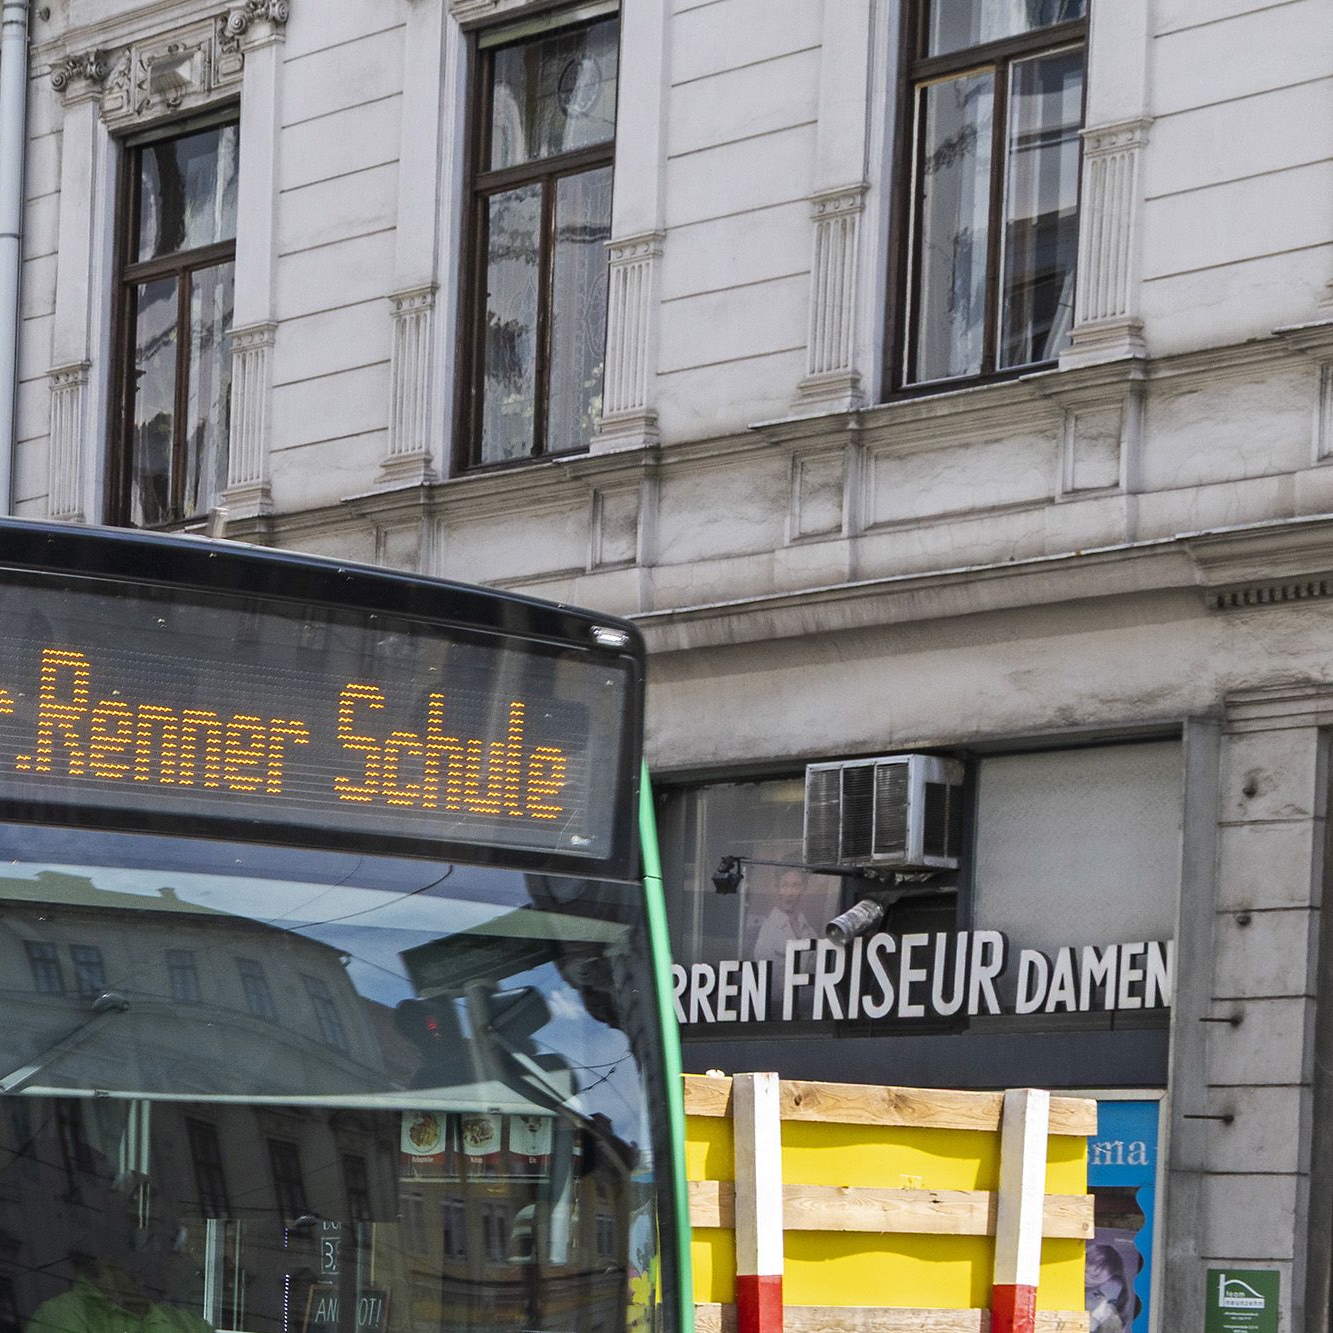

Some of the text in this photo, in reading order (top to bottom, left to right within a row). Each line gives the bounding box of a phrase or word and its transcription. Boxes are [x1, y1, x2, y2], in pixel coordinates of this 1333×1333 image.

[333, 682, 568, 820] Schule
[670, 929, 1174, 1024] RREN FRISEUR DAMEN
[1087, 1139, 1150, 1166] ma
[314, 1297, 383, 1328] ANOT!
